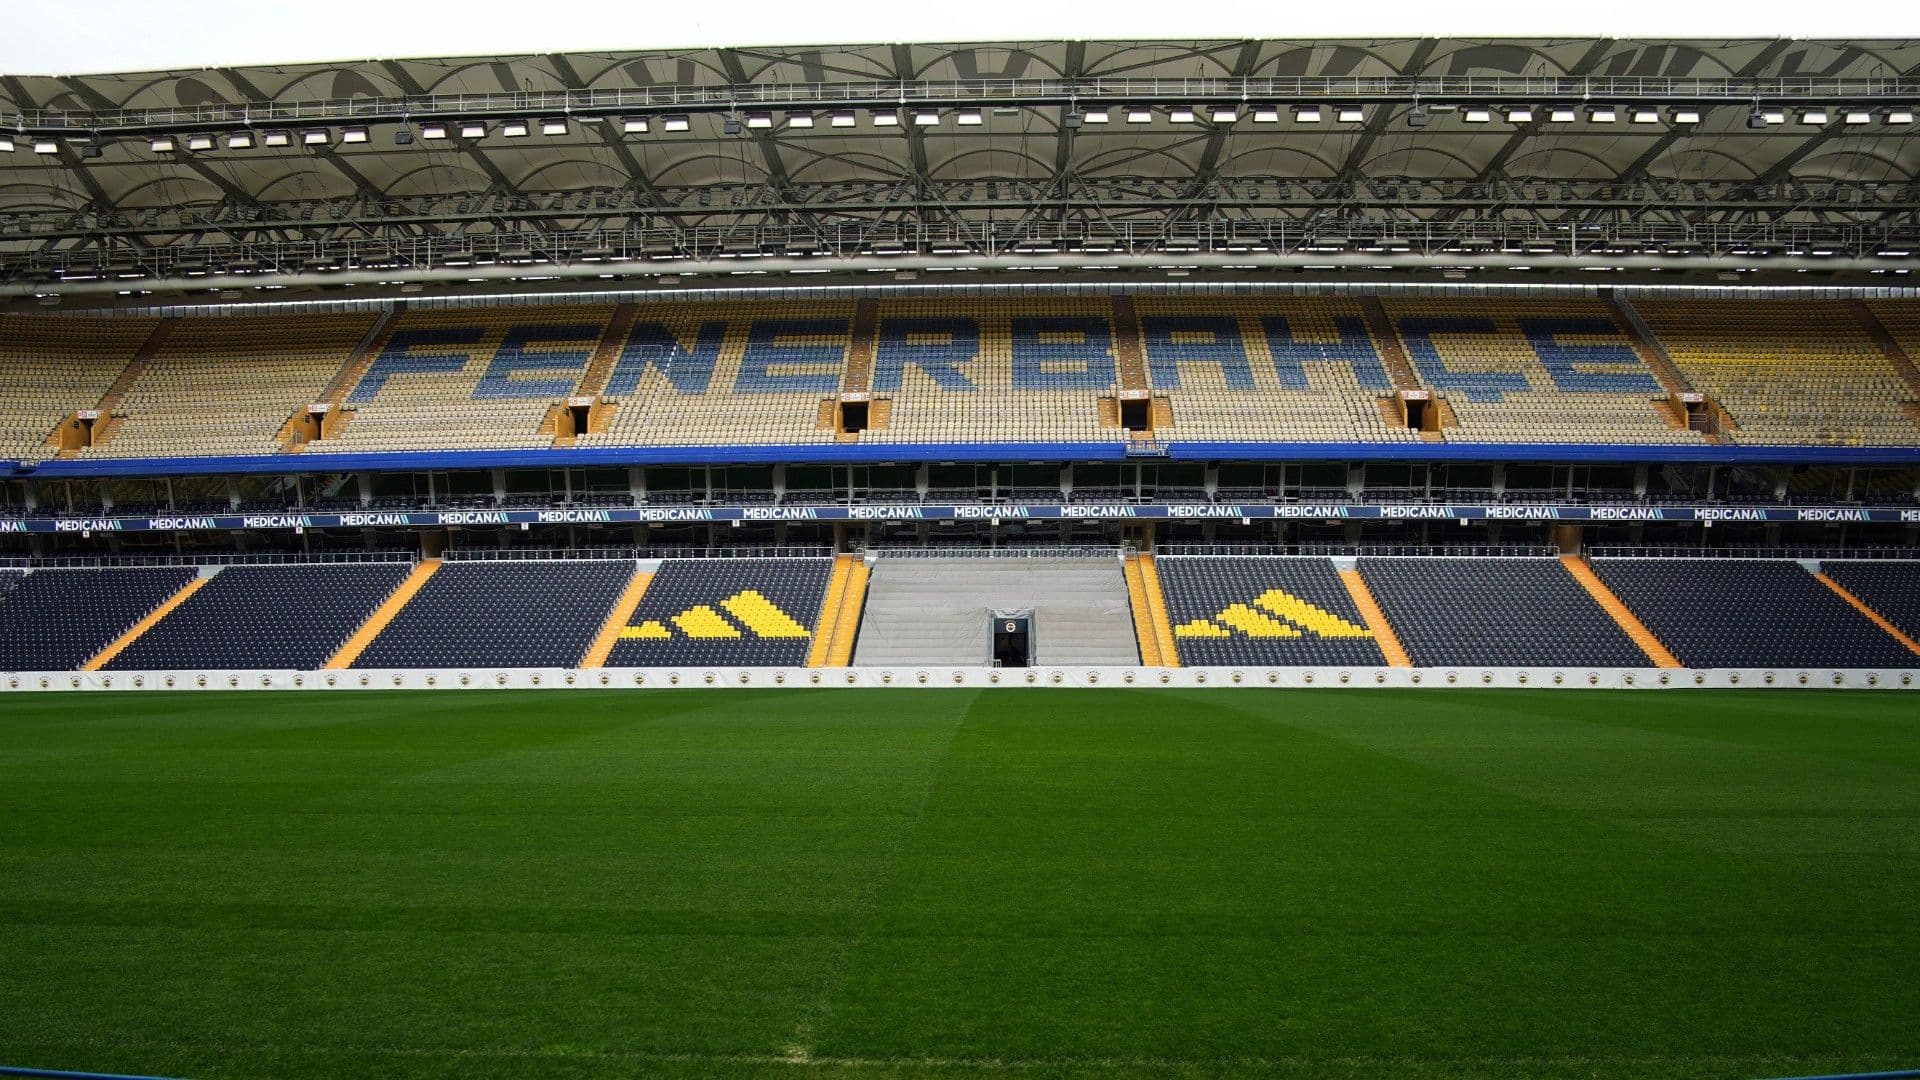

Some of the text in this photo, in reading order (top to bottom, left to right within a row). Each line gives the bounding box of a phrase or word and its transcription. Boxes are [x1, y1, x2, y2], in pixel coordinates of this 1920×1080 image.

[348, 316, 1663, 402] FENERBAHÇE
[640, 510, 704, 520] MEDICANA
[743, 509, 808, 518] MEDICANA
[848, 508, 914, 518] MEDICANA
[954, 507, 1021, 517] MEDICANA
[1061, 507, 1127, 516] MEDICANA
[1168, 507, 1234, 516] MEDICANA
[1274, 507, 1340, 517] MEDICANA
[1381, 507, 1446, 517] MEDICANA
[1486, 508, 1551, 518] MEDICANA
[1590, 508, 1655, 519] MEDICANA
[1694, 510, 1759, 520] MEDICANA
[1798, 510, 1862, 520] MEDICANA
[340, 515, 401, 525] MEDICANA
[439, 514, 500, 524] MEDICANA
[538, 512, 601, 522] MEDICANA
[56, 521, 114, 530] MEDICANA
[149, 520, 208, 529] MEDICANA
[244, 518, 303, 527] MEDICANA
